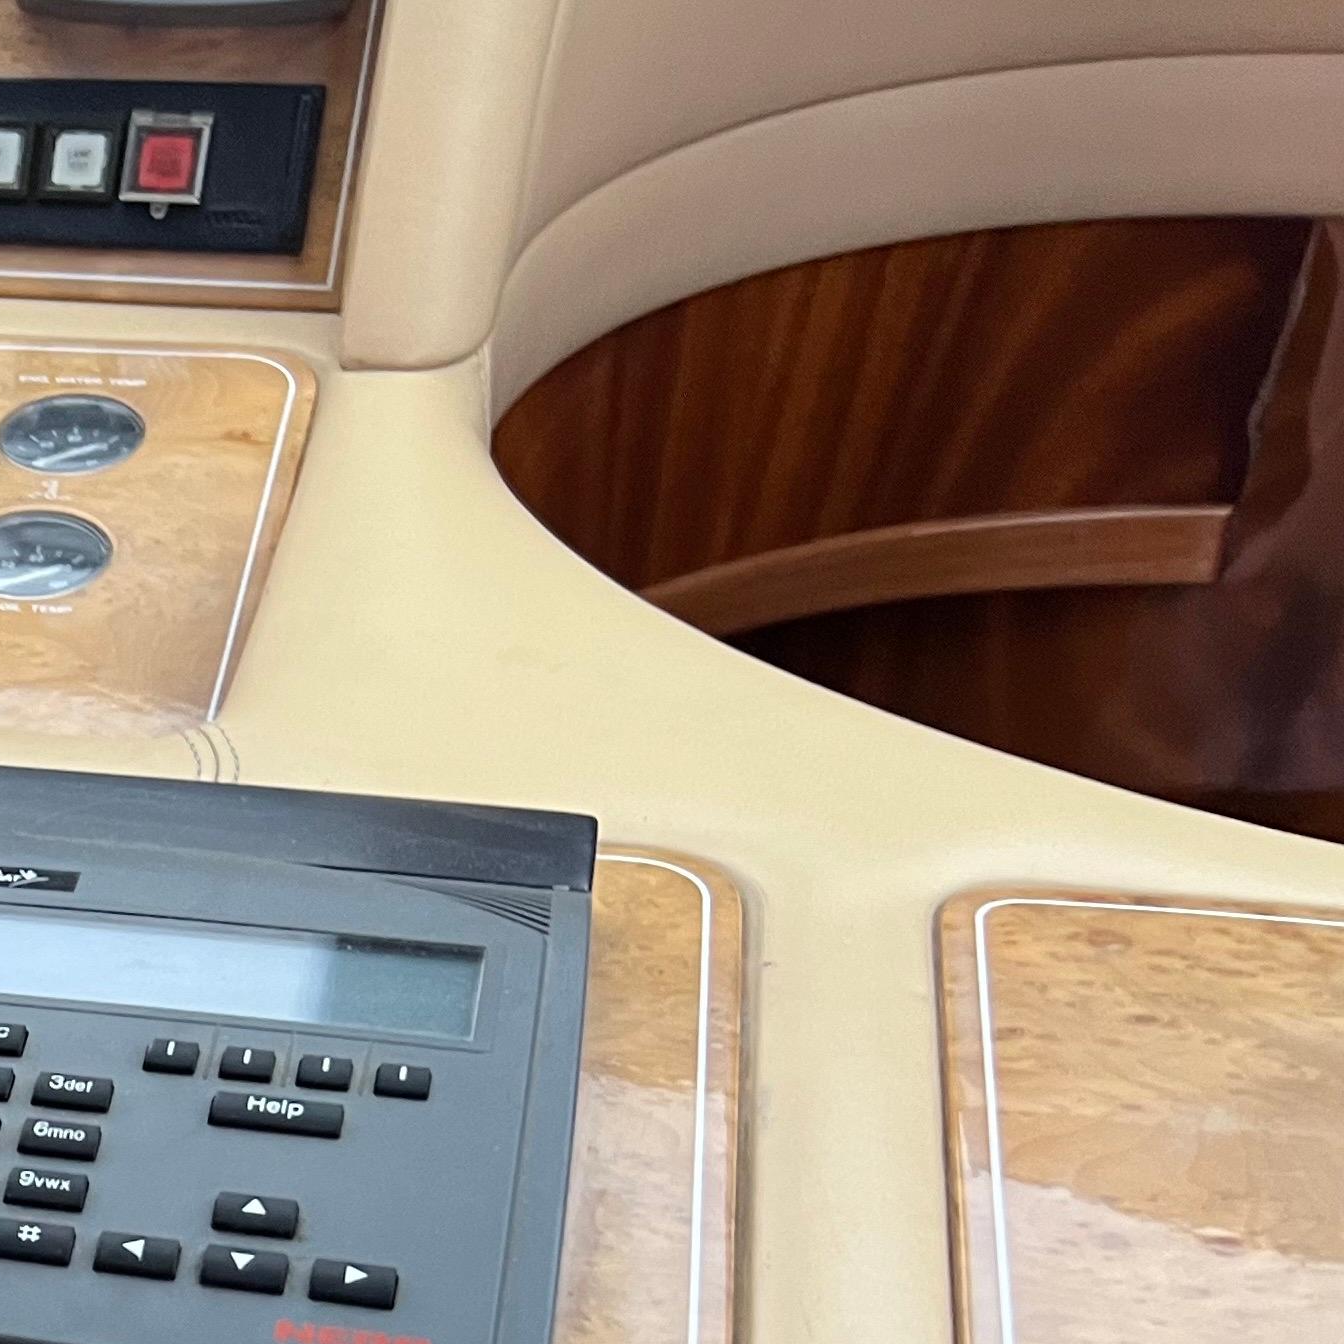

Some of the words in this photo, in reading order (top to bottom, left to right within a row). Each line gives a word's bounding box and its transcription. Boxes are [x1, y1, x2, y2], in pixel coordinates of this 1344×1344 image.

[48, 1075, 94, 1093] 3def
[247, 1095, 305, 1120] Help
[33, 1121, 86, 1142] 6mno
[18, 1170, 71, 1192] 9vwx
[17, 1224, 42, 1243] #
